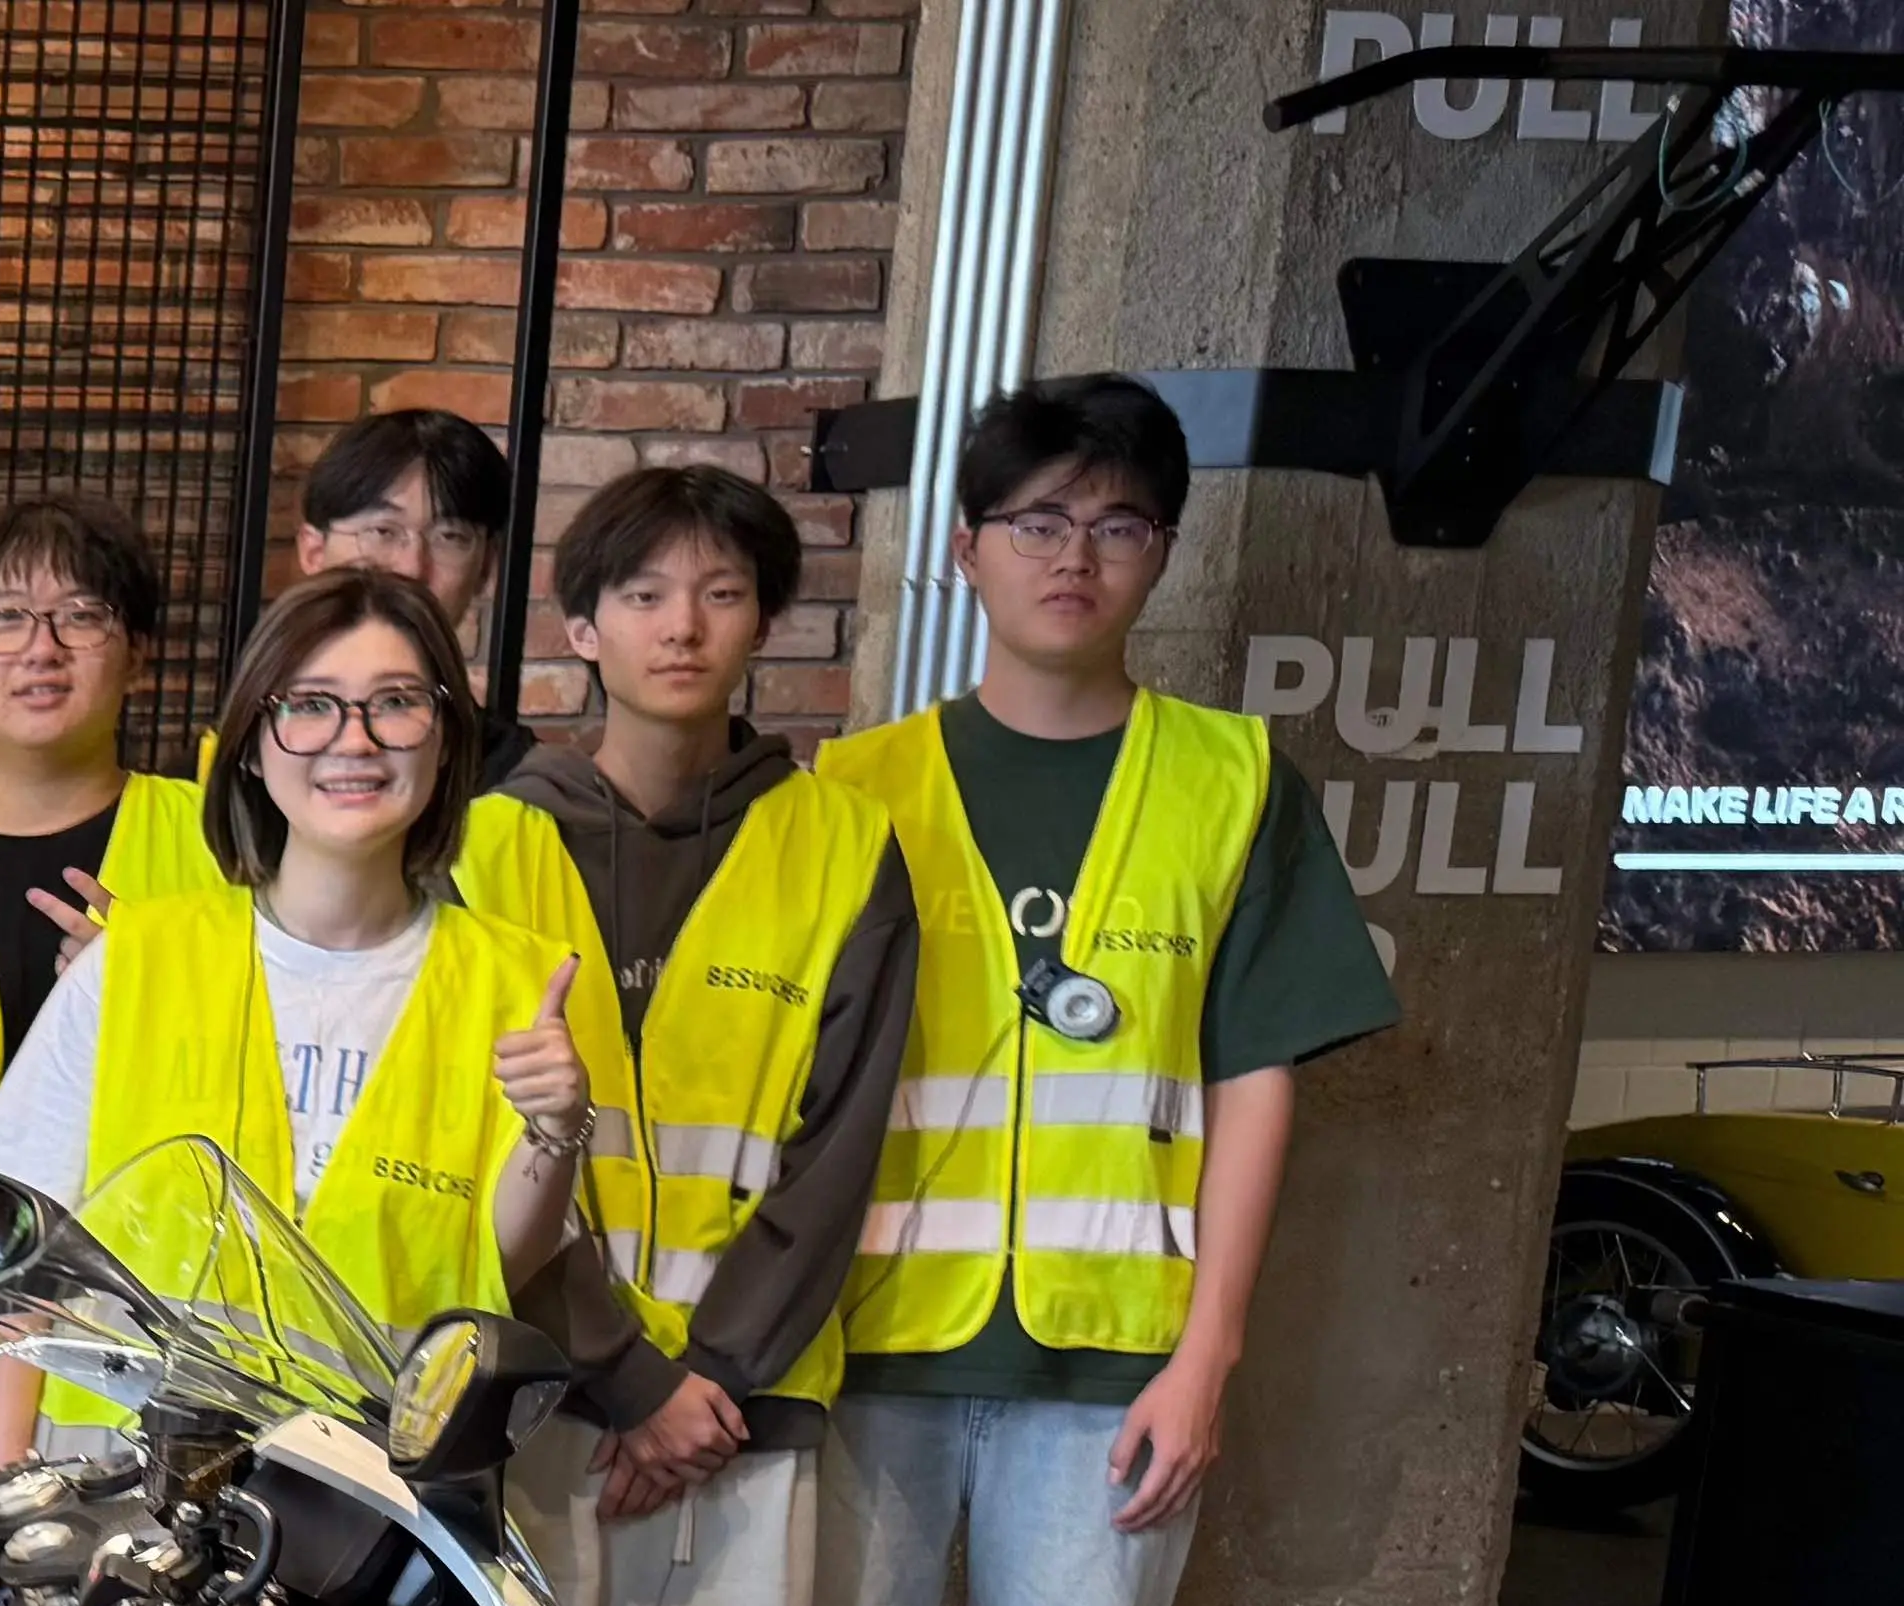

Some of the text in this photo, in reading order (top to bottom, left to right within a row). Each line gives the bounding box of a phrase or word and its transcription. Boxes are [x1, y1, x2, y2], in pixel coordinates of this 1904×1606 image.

[1313, 10, 1666, 142] PULL
[1242, 634, 1584, 754] PULL
[1322, 779, 1563, 896] ULL
[1622, 785, 1904, 825] MAKE LIFE A R
